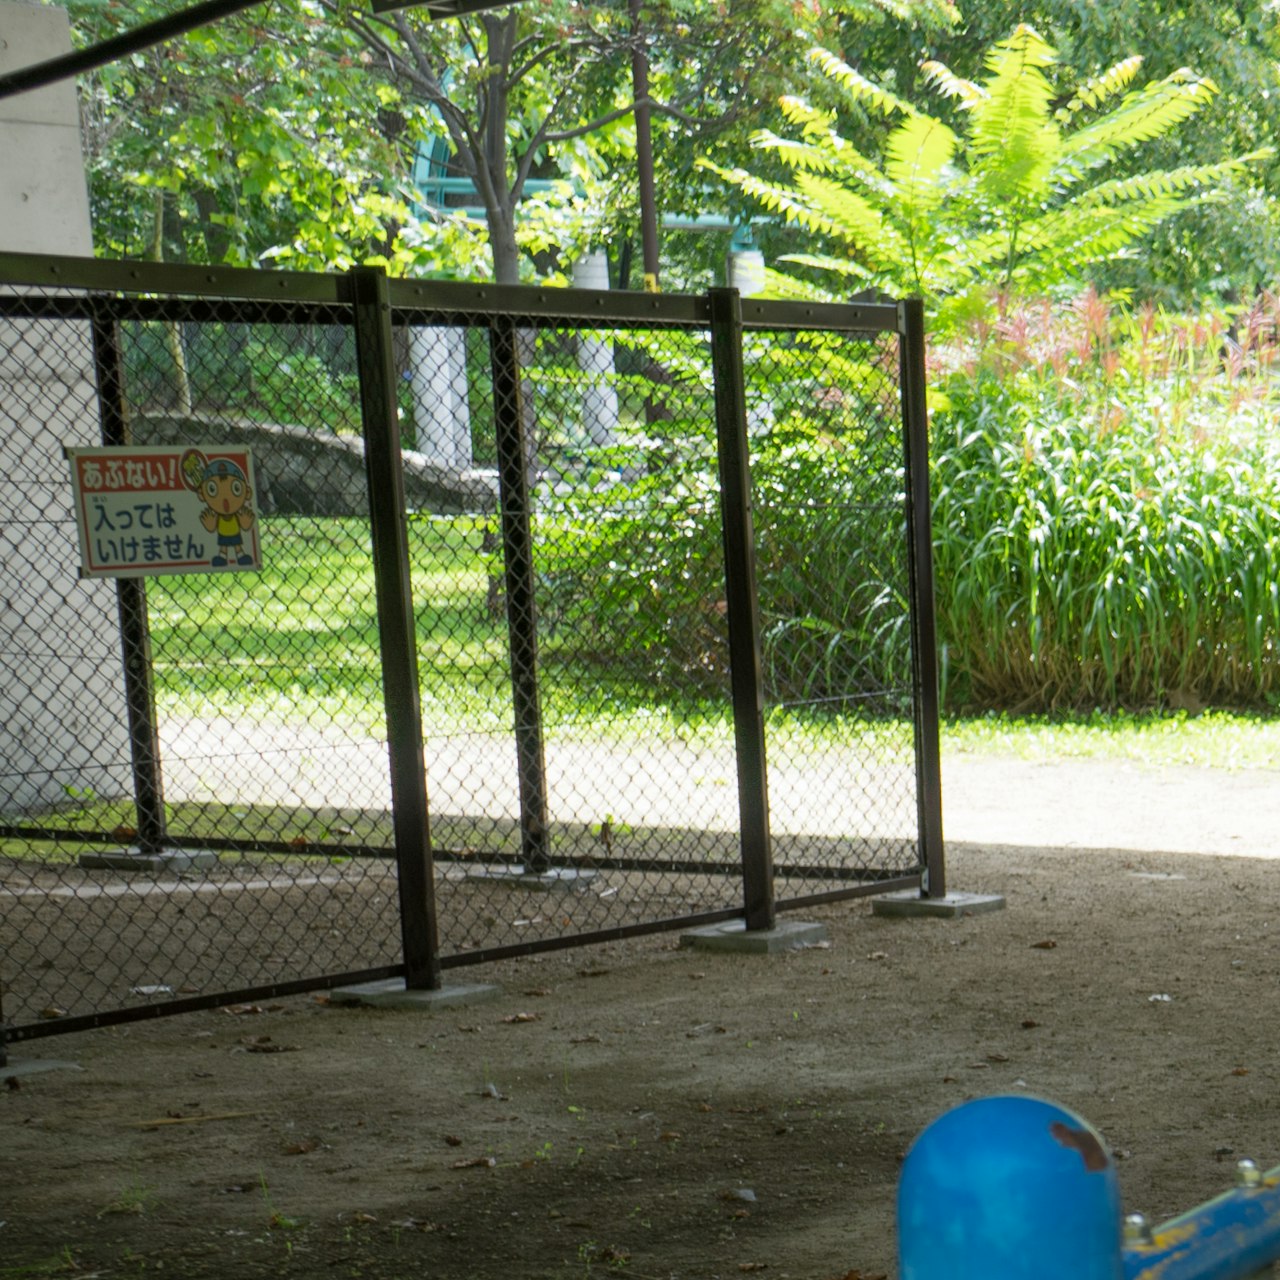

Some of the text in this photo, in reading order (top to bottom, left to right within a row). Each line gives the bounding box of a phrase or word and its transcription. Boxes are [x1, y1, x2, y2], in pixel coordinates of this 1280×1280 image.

[82, 459, 176, 489] あぶない!
[94, 503, 177, 532] 入っては
[96, 534, 205, 563] いけません
